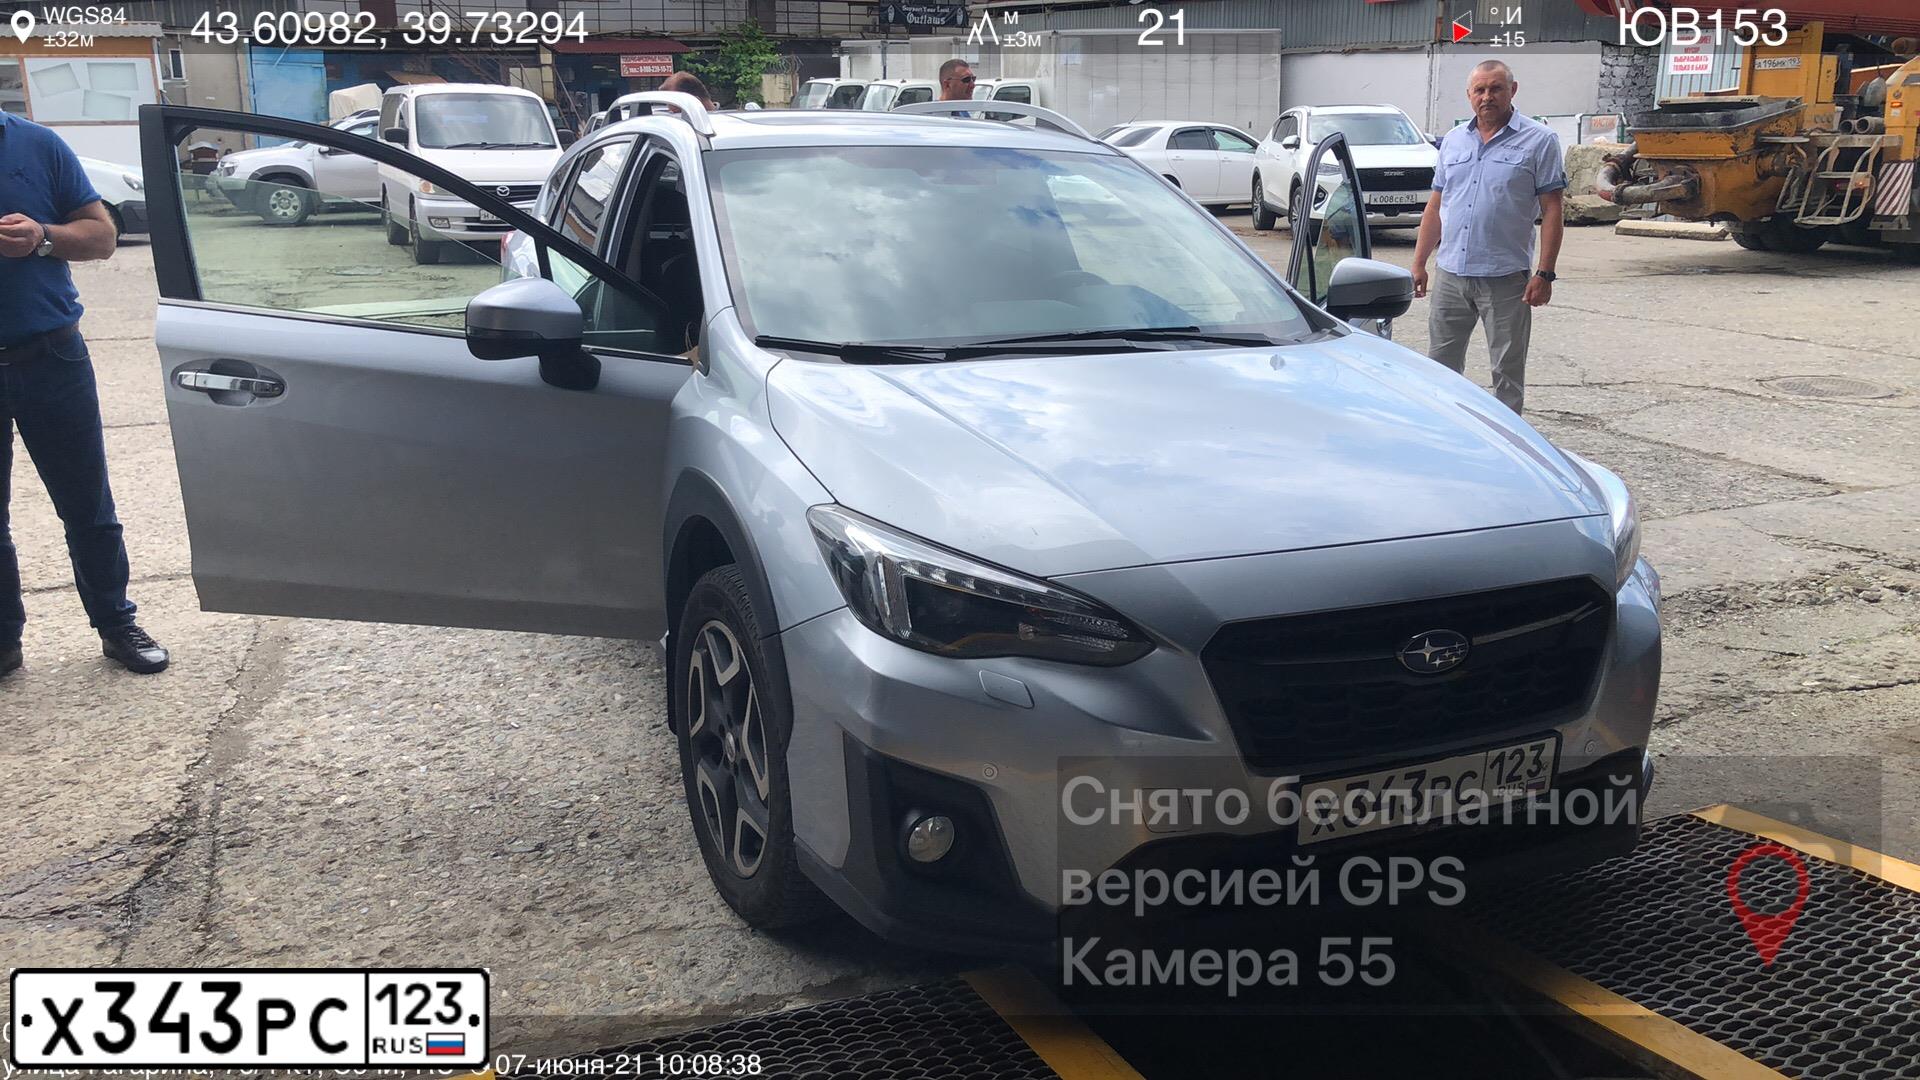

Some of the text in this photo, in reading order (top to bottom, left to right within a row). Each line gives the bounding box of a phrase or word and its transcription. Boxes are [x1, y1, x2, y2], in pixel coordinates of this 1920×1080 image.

[907, 12, 946, 25] Outlaws
[1695, 63, 1709, 71] БАКИ
[1489, 743, 1546, 786] 123
[1311, 768, 1479, 837] Х343РС
